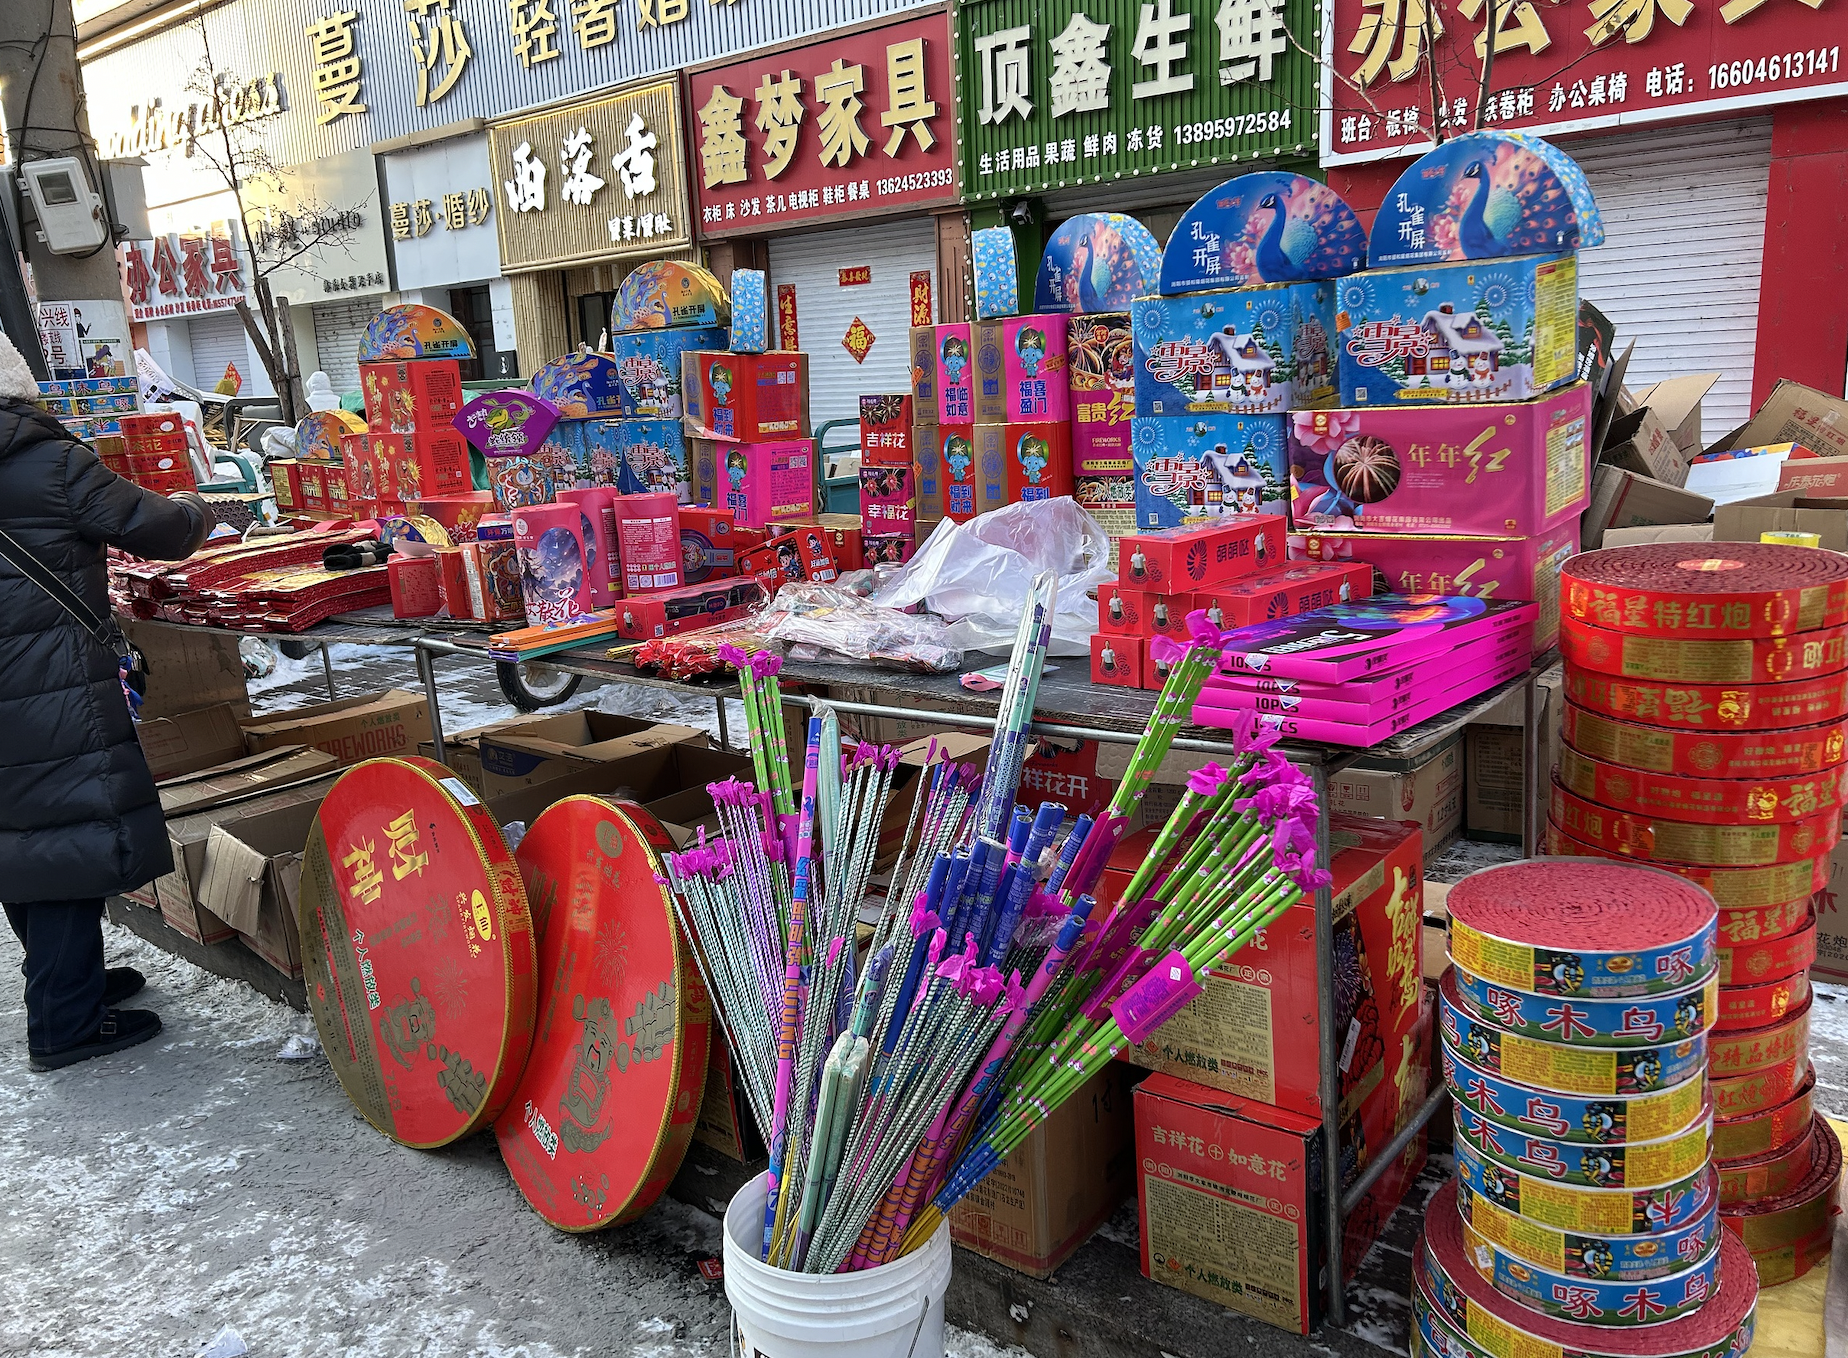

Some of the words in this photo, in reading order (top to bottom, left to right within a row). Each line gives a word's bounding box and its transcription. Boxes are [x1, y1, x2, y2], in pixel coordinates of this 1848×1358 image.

[975, 0, 1288, 125] 顶鑫生鲜
[1548, 73, 1628, 113] 办公桌椅
[1708, 46, 1839, 90] 16604613141
[698, 37, 938, 190] 鑫梦家具
[979, 144, 1041, 176] 生活用品
[1044, 137, 1077, 165] 果蔬
[1083, 131, 1118, 158] 鲜肉
[1127, 126, 1164, 153] 冻货
[1173, 109, 1292, 146] 13895972584
[702, 204, 723, 224] 衣柜
[725, 201, 736, 218] 床
[740, 198, 762, 217] 沙发
[765, 194, 787, 213] 茶几
[788, 188, 820, 210] 电视柜
[822, 185, 846, 206] 鞋柜
[847, 180, 871, 201] 餐桌
[876, 168, 953, 196] 13624523393
[126, 222, 243, 306] 办公家具
[1190, 221, 1222, 276] 孔雀开屏
[849, 325, 868, 350] 福
[1347, 319, 1432, 369] 雪景
[1145, 340, 1220, 383] 雪景
[944, 386, 969, 402] 福临
[1019, 379, 1047, 397] 福喜
[1019, 397, 1048, 415] 盈门
[1076, 391, 1135, 427] 富贵红
[945, 402, 969, 418] 如意
[866, 432, 906, 449] 吉祥花
[1407, 426, 1512, 484] 年年红
[949, 485, 973, 500] 福到
[1141, 455, 1212, 496] 雪景
[867, 503, 910, 521] 幸福花
[949, 499, 973, 514] 财来
[1216, 541, 1250, 564] 萌萌哒
[1589, 589, 1751, 630] 福星特红炮
[341, 807, 430, 906] 财神
[352, 928, 382, 1010] 个人燃放类
[1486, 986, 1666, 1042] 啄木鸟
[1162, 1045, 1220, 1073] 个人燃放类
[1151, 1124, 1205, 1158] 吉祥花
[1228, 1148, 1287, 1182] 如意花
[1184, 1263, 1244, 1297] 个人燃放类
[1552, 1273, 1711, 1323] 啄木鸟
